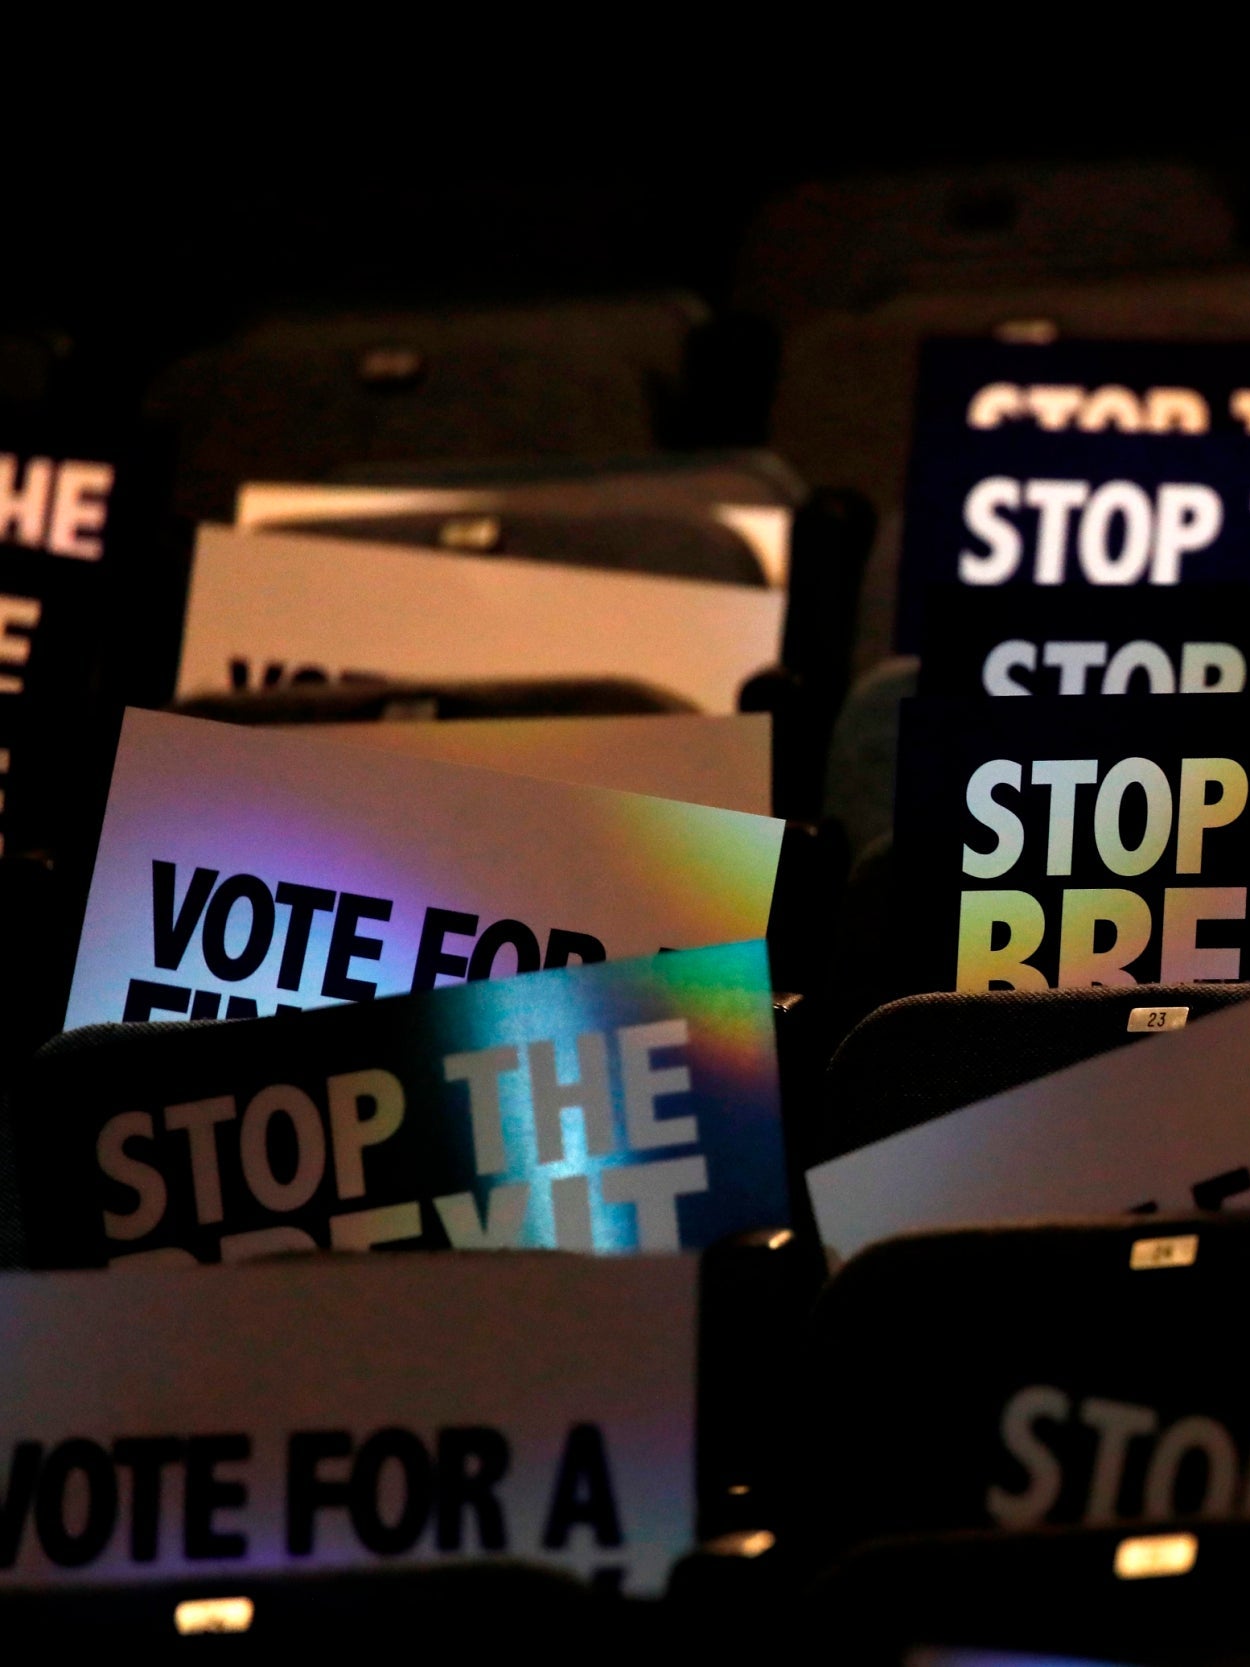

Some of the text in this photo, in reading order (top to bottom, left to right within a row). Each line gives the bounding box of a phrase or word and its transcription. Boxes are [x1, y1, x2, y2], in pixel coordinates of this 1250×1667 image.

[957, 476, 1225, 588] STOP
[962, 757, 1249, 880] STOP
[151, 860, 393, 1001] VOTE
[1147, 1012, 1167, 1028] 23
[96, 1018, 699, 1242] STOP THE
[288, 1427, 509, 1557] FOR
[545, 1424, 623, 1549] A
